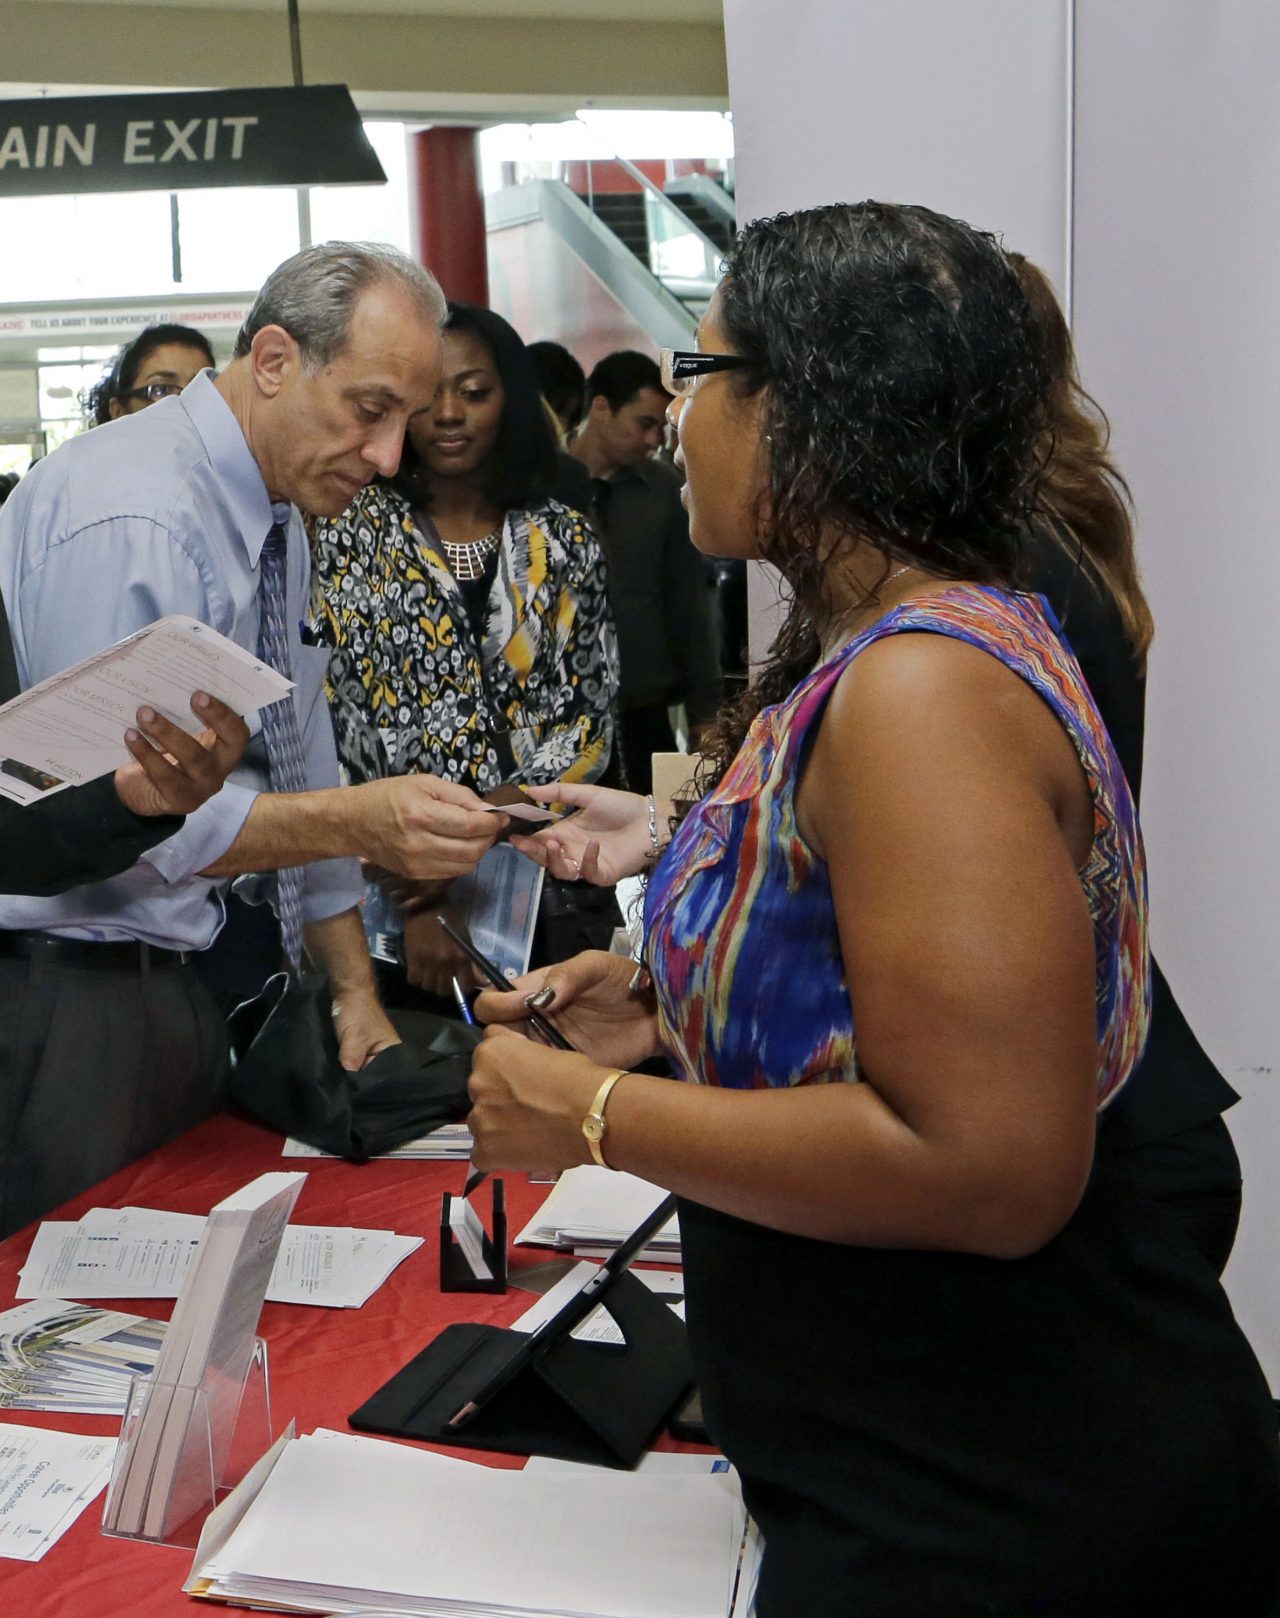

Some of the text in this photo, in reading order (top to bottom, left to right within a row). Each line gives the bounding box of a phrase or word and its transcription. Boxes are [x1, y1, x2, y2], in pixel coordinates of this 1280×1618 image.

[123, 116, 259, 163] EXIT
[30, 319, 48, 329] TELL
[49, 319, 60, 328] US
[61, 317, 87, 328] ABOUT
[89, 316, 109, 326] YOUR
[110, 314, 159, 325] EXPERIENCE
[159, 313, 169, 322] AT
[24, 1460, 52, 1479] Career
